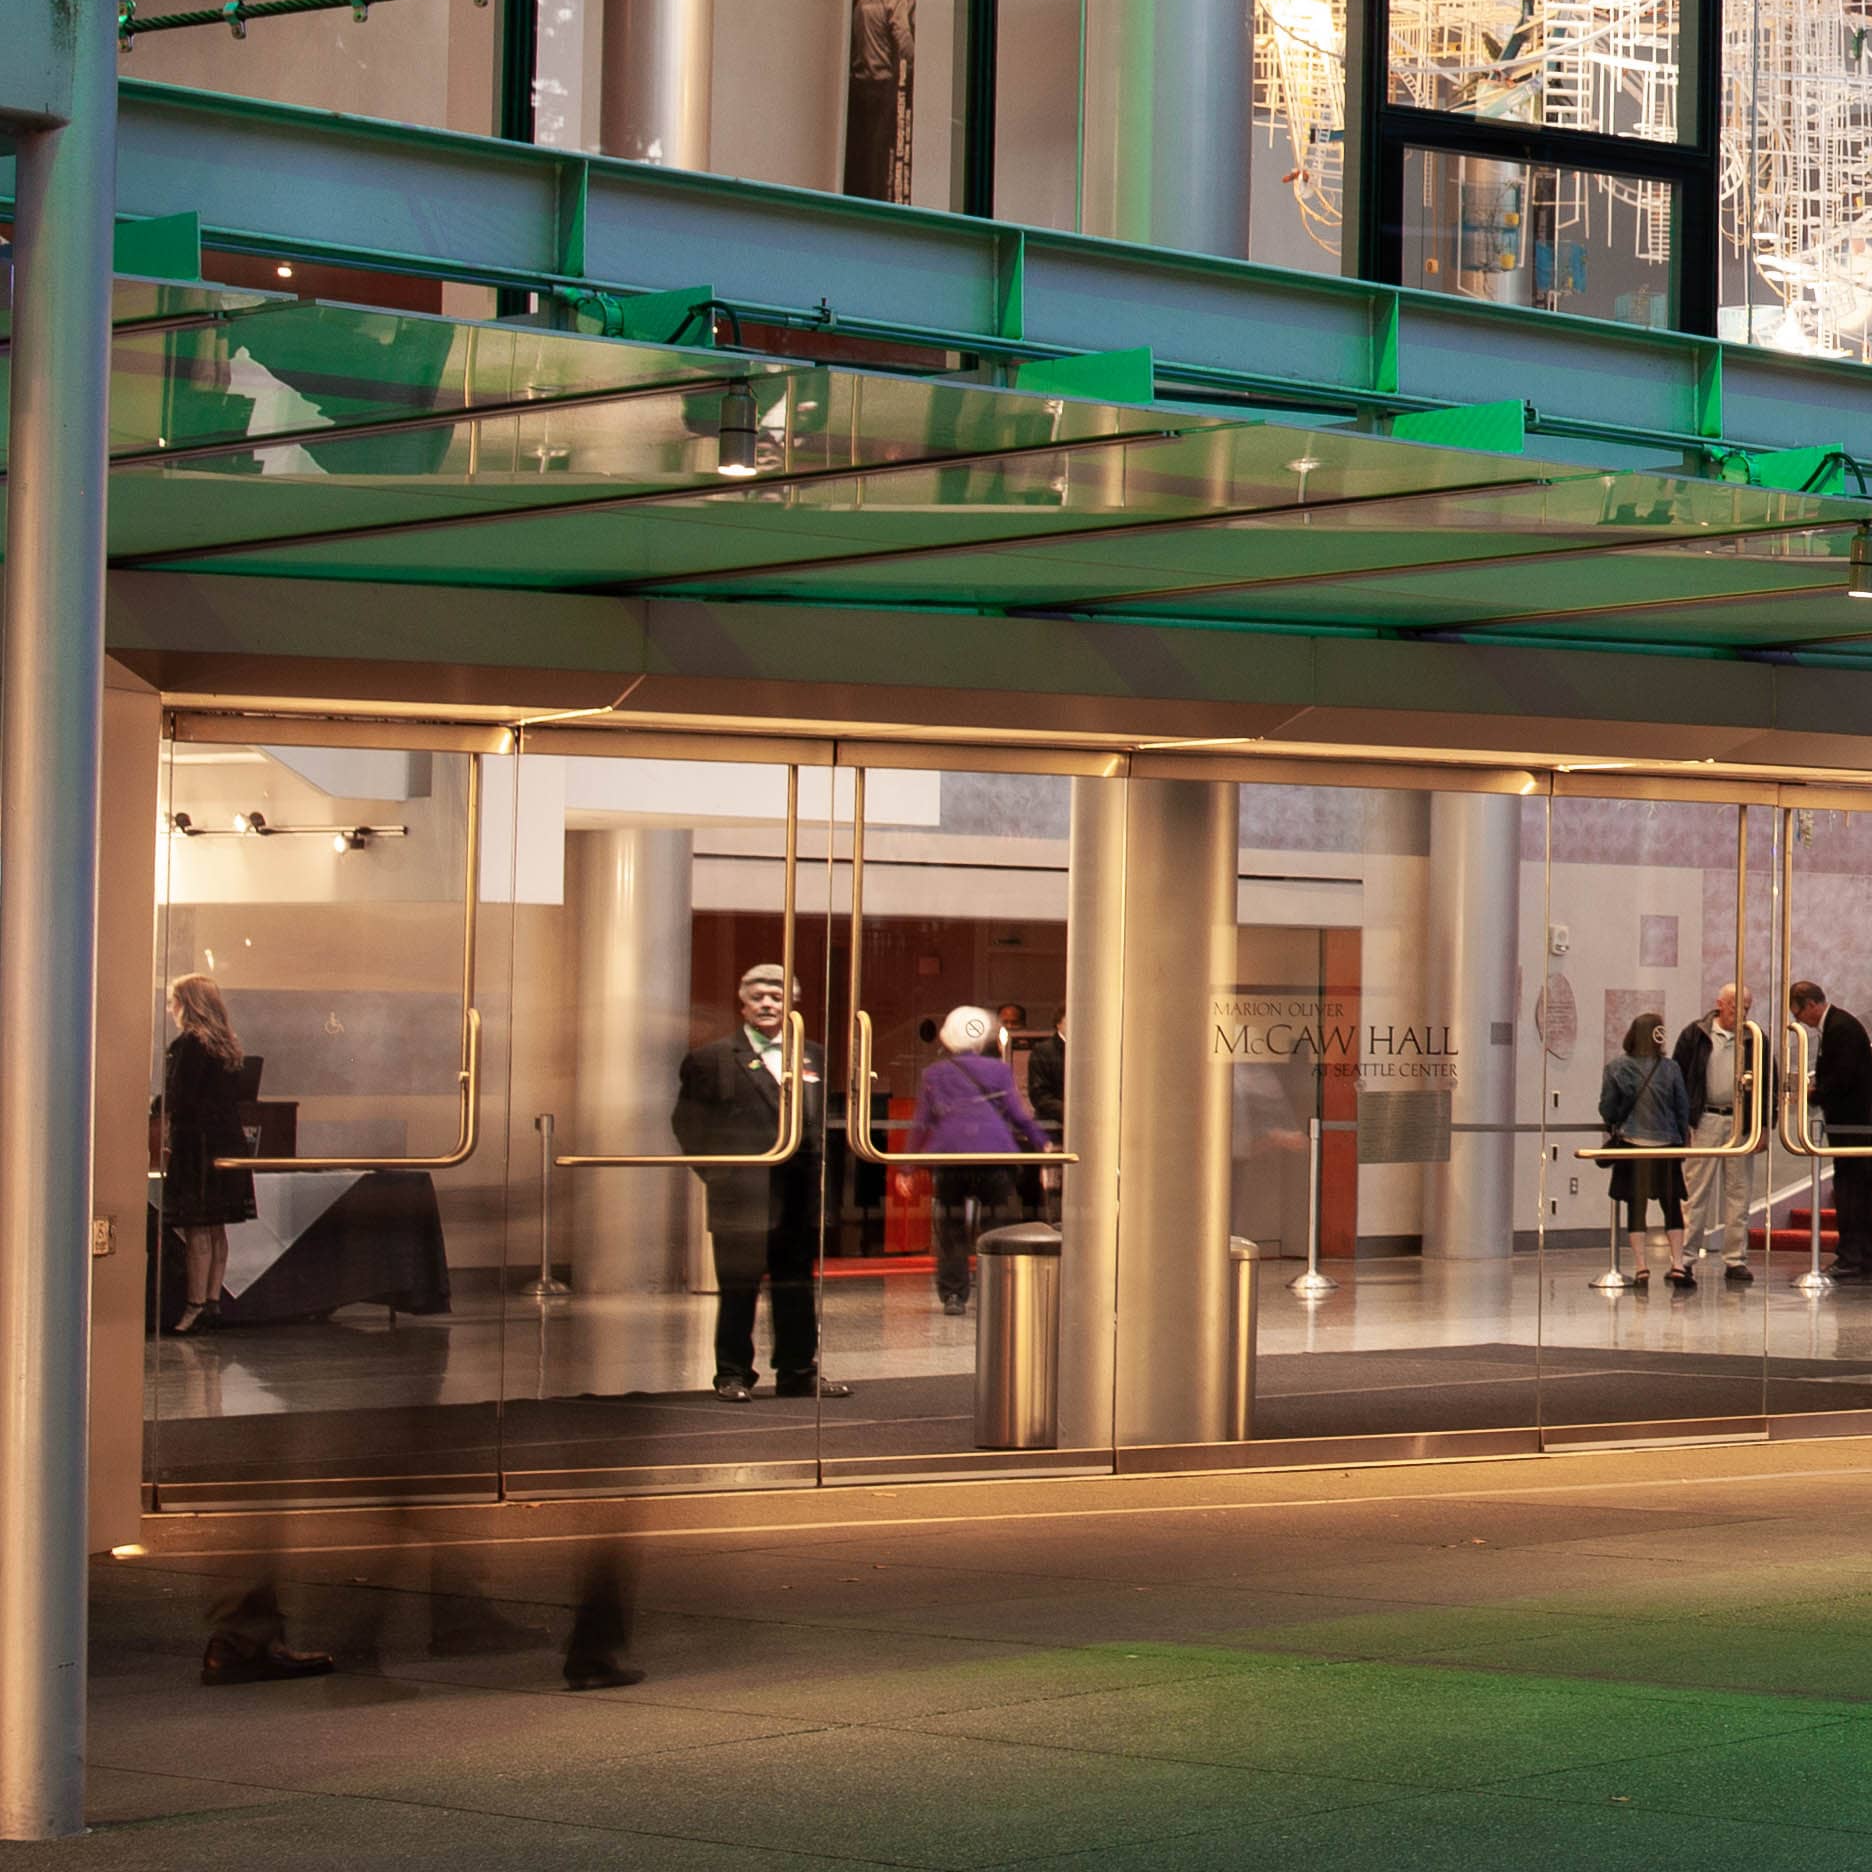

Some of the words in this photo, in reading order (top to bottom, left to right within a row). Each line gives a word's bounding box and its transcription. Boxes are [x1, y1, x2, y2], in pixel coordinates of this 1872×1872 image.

[1213, 1002, 1282, 1017] MARION
[1287, 1002, 1344, 1017] OLIVER
[1369, 1025, 1459, 1056] HALL
[1311, 1063, 1330, 1077] AT
[1333, 1063, 1396, 1077] SEATTLE
[1399, 1063, 1458, 1077] CENTER
